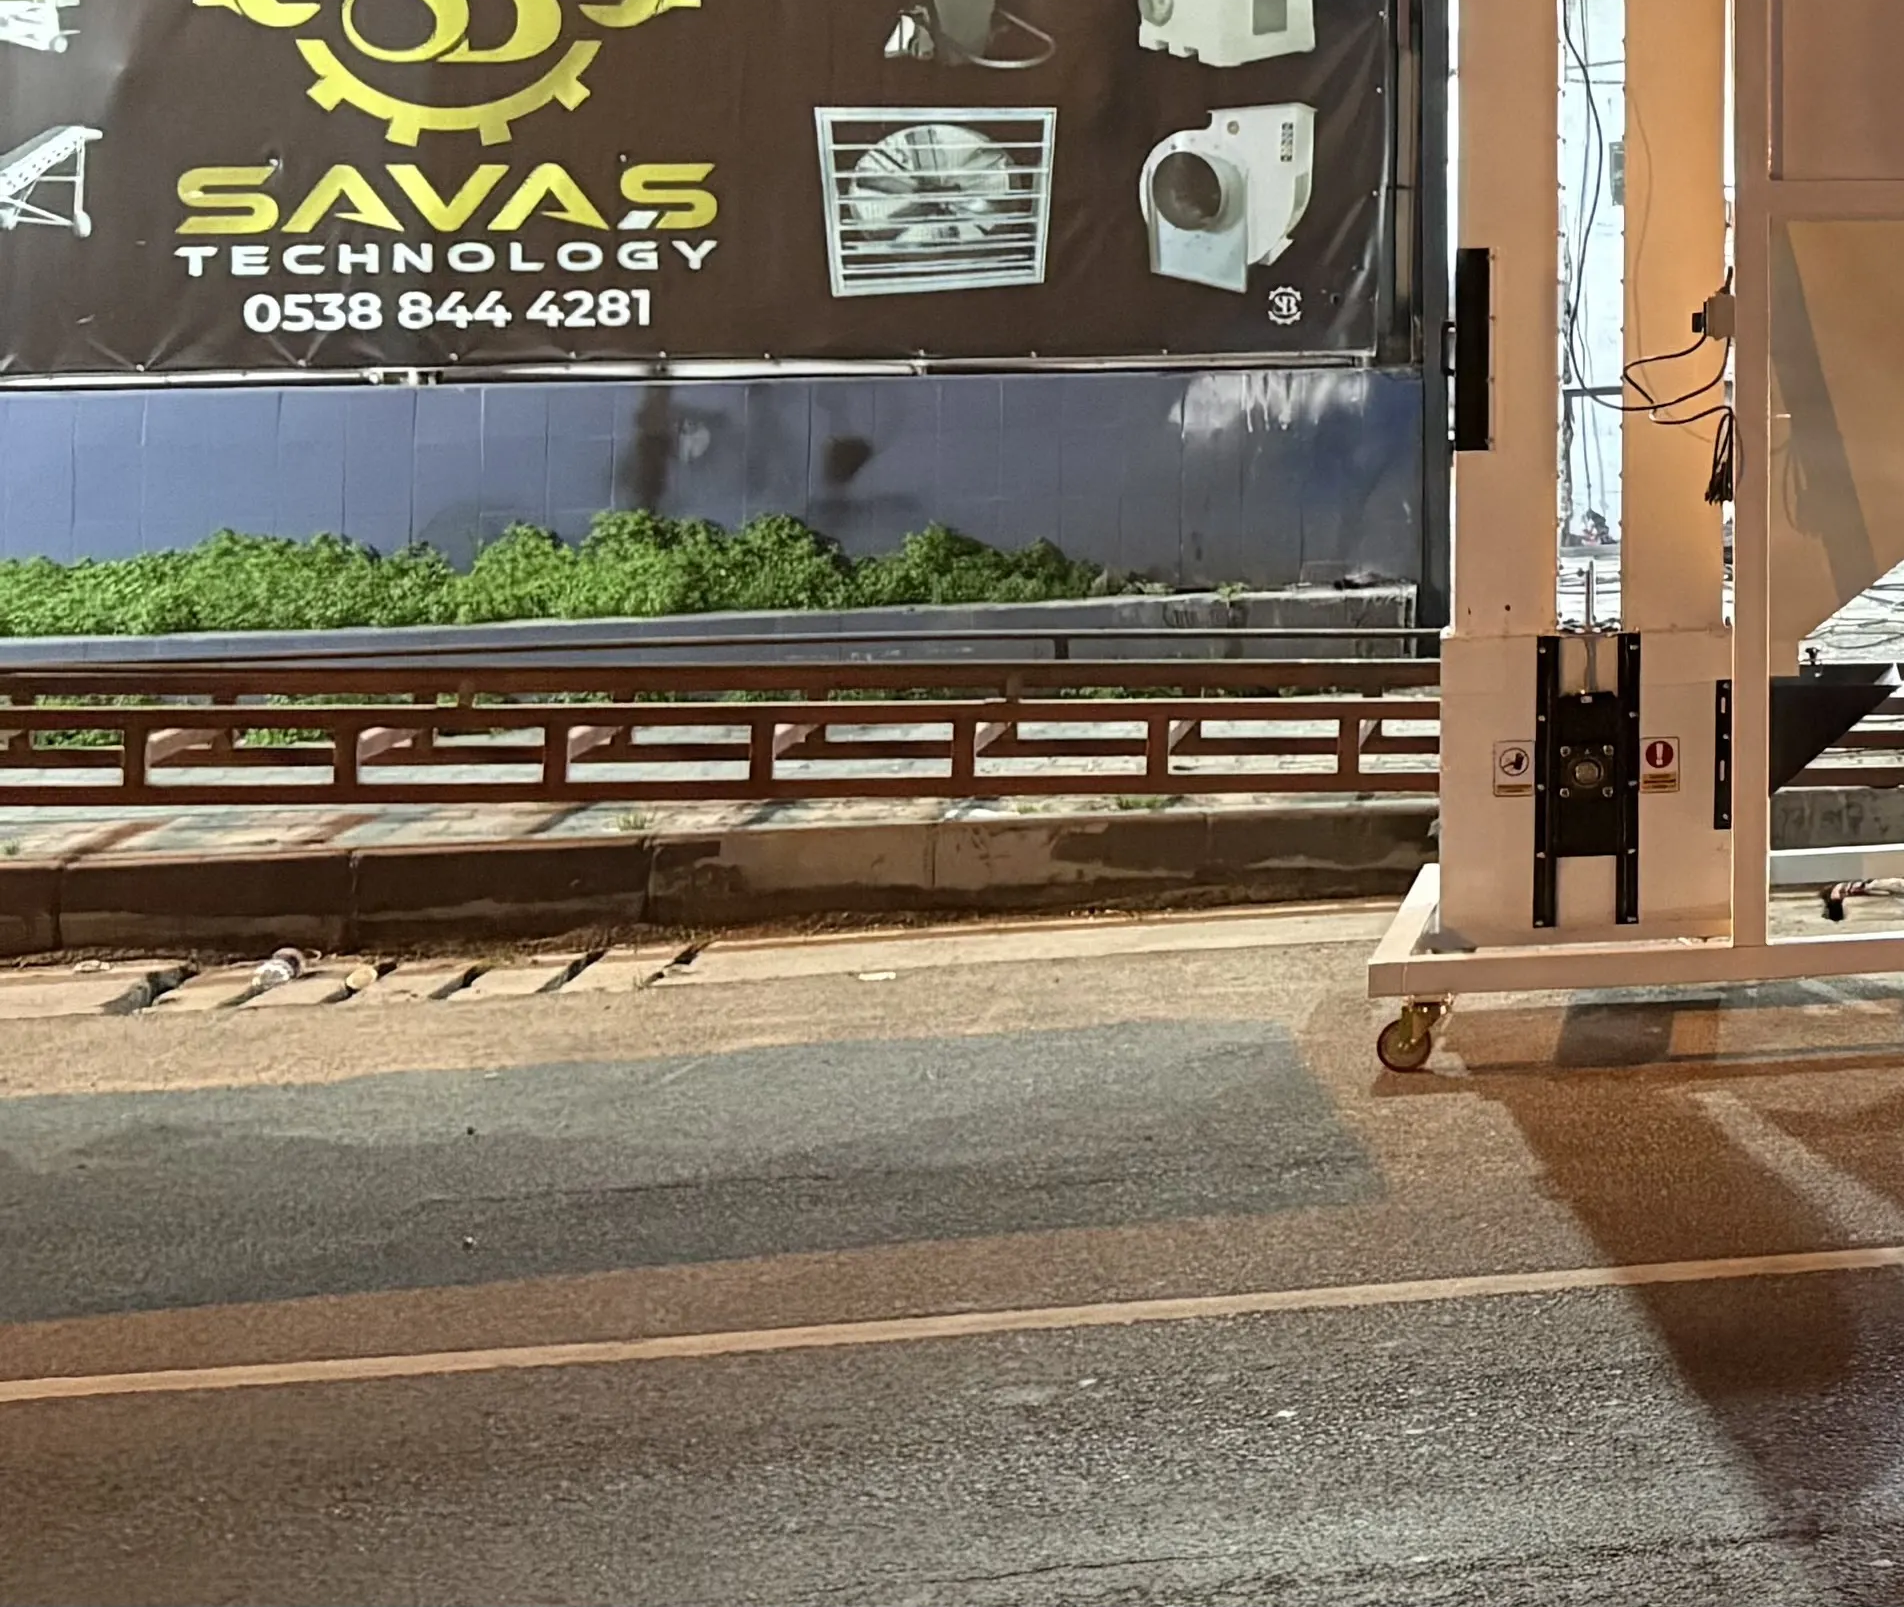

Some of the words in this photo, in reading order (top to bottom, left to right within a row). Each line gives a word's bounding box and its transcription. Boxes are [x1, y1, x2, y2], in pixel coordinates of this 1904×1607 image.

[174, 240, 719, 277] TECHNOLOGY
[242, 291, 383, 333] 0538
[397, 291, 512, 330] 844
[525, 288, 652, 327] 4281
